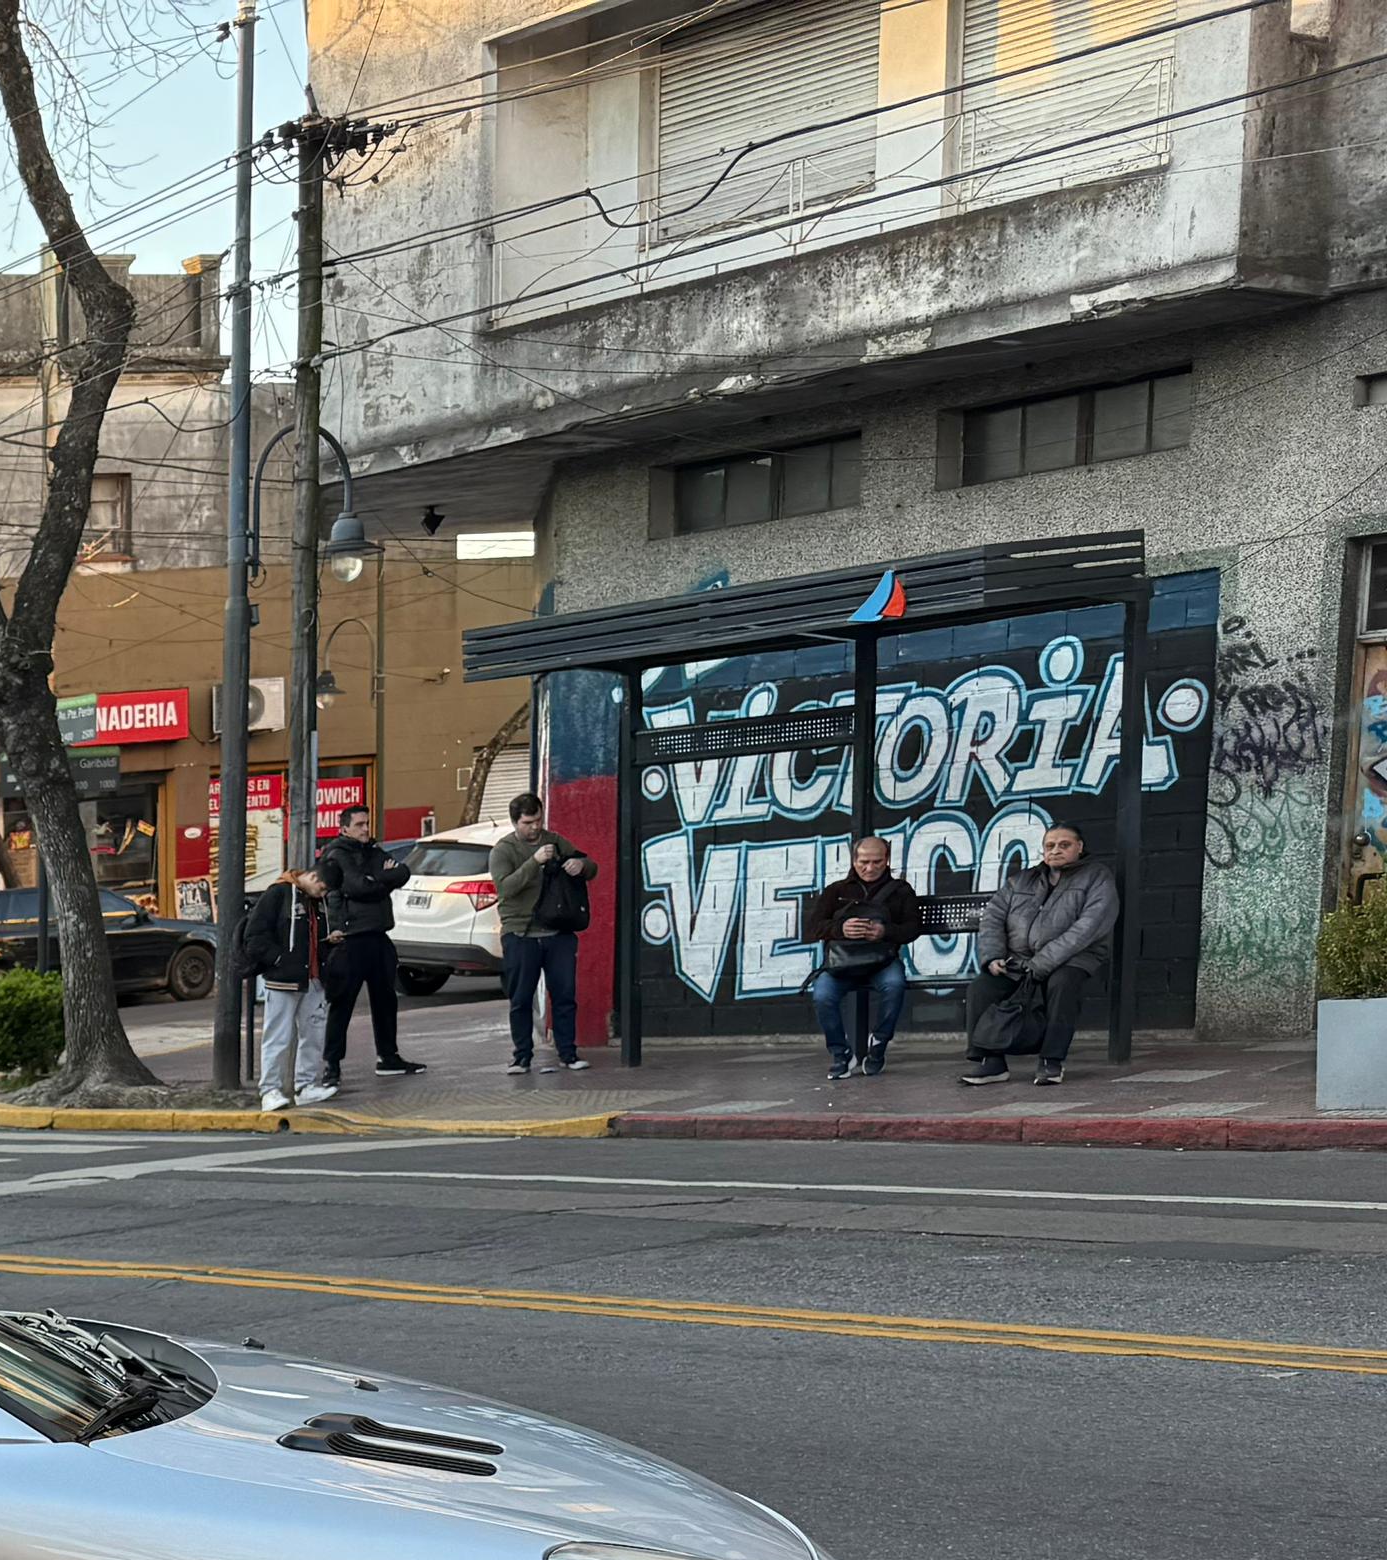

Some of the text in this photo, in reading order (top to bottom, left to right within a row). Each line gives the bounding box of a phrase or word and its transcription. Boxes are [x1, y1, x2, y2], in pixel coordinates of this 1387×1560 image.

[96, 701, 178, 732] NADERIA
[79, 758, 117, 768] Garibaldi
[257, 780, 270, 791] EN
